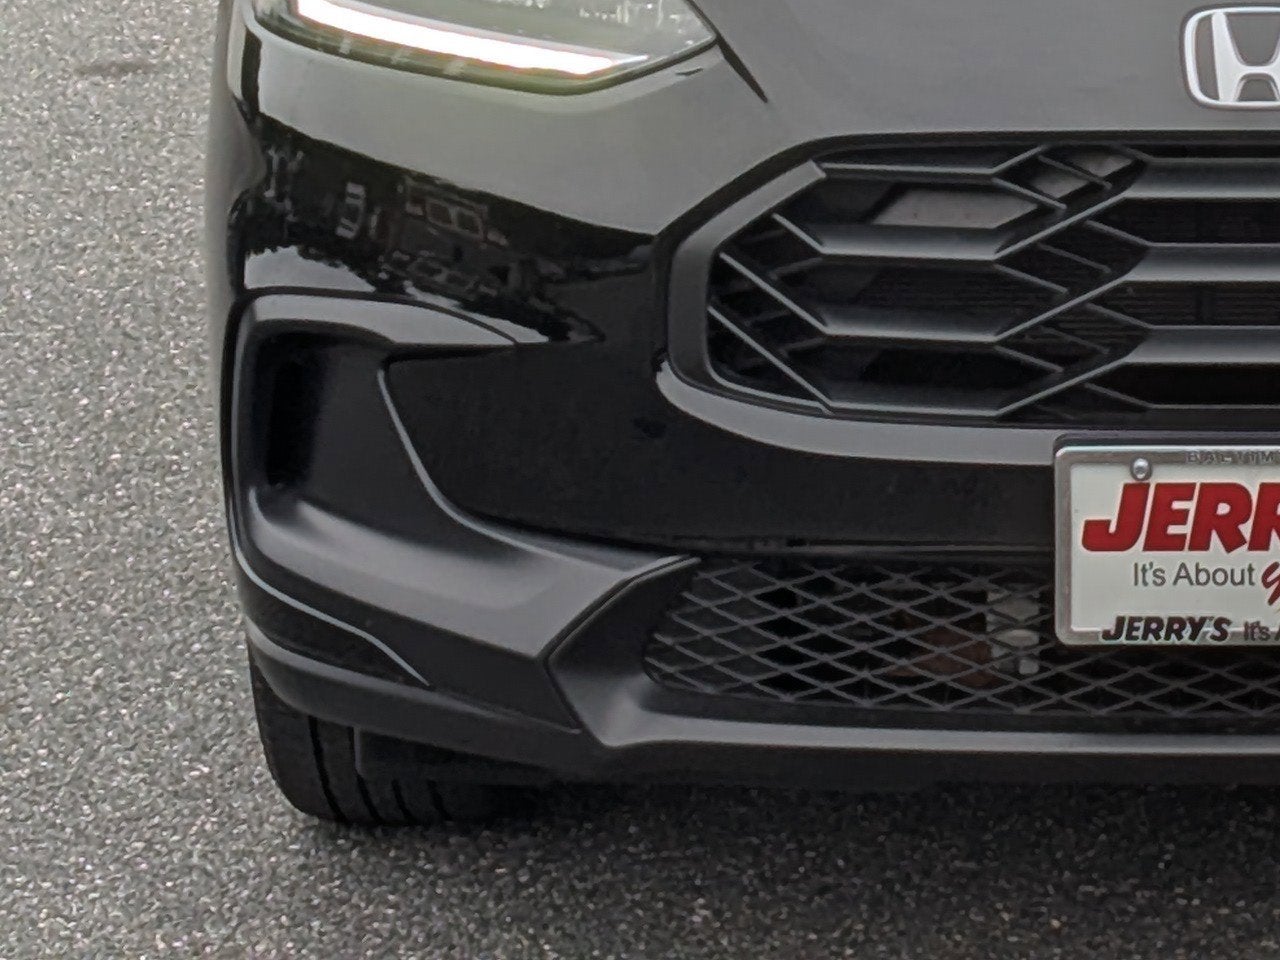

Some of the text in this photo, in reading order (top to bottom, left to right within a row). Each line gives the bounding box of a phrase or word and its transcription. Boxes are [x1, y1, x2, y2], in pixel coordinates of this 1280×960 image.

[1133, 562, 1167, 587] It's
[1173, 562, 1256, 587] About
[1101, 615, 1232, 642] JERRY'S
[1243, 620, 1271, 642] It's
